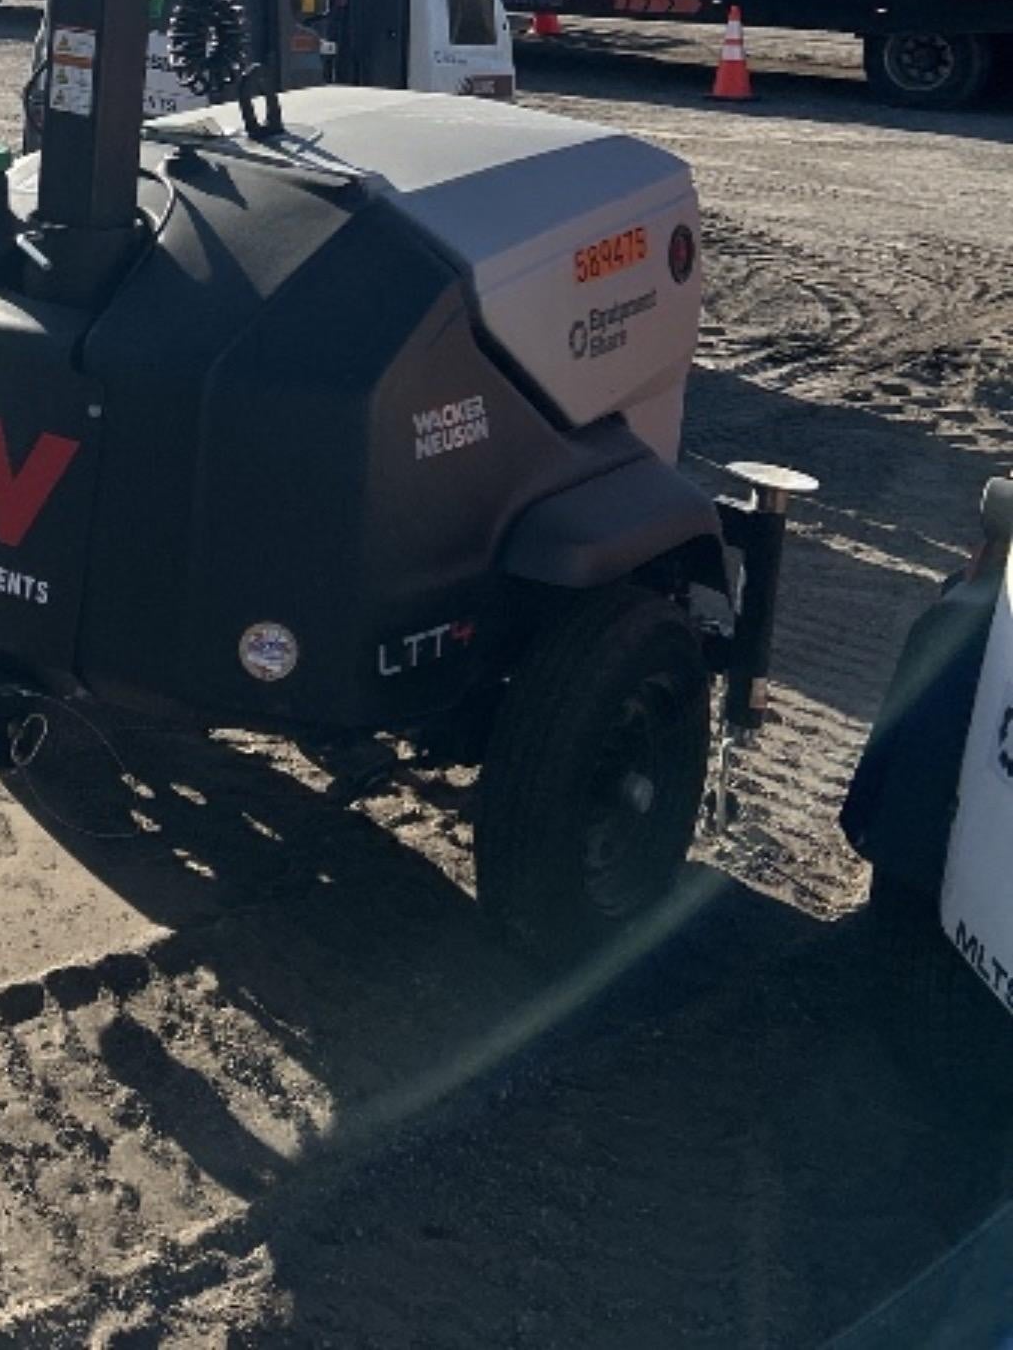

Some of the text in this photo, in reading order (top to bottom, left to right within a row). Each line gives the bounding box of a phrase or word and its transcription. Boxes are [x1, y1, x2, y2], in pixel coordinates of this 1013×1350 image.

[574, 226, 645, 283] 589475
[412, 395, 486, 435] WACKER
[415, 416, 489, 460] NEUSON
